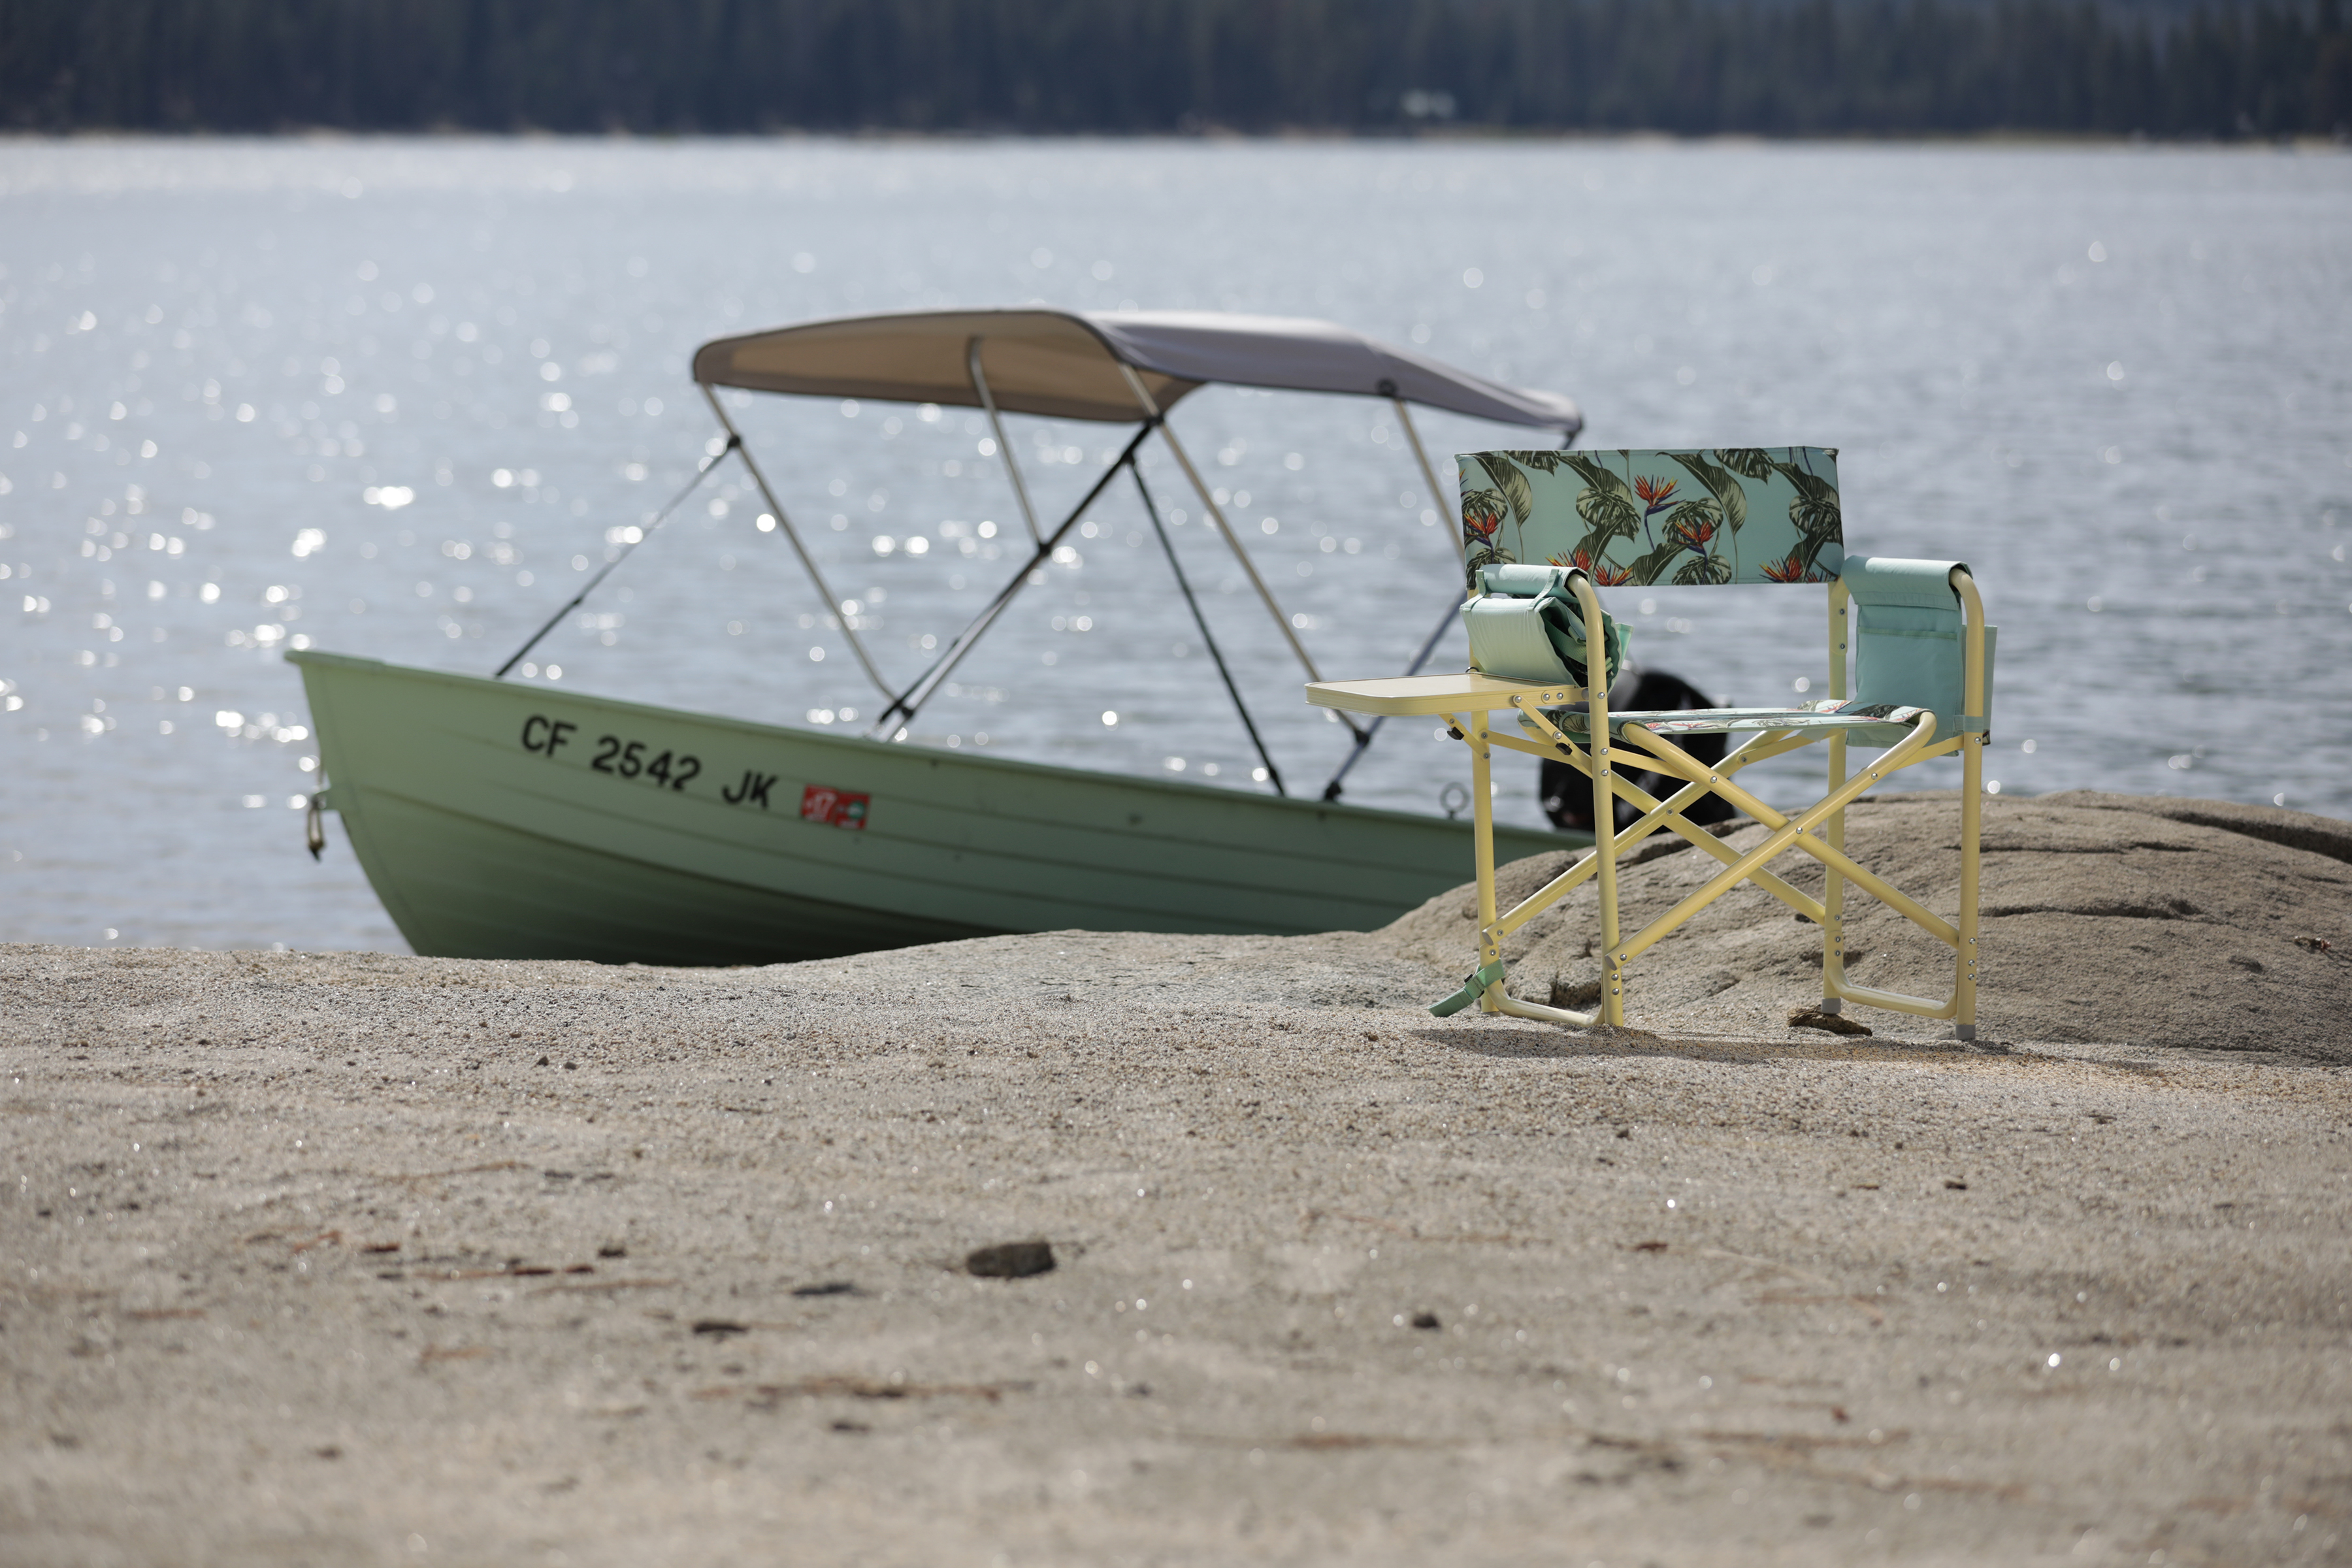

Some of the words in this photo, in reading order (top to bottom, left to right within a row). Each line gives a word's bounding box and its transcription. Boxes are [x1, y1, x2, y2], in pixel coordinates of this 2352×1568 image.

[521, 714, 577, 758] CF
[591, 735, 701, 791] 2542
[722, 770, 778, 809] JK
